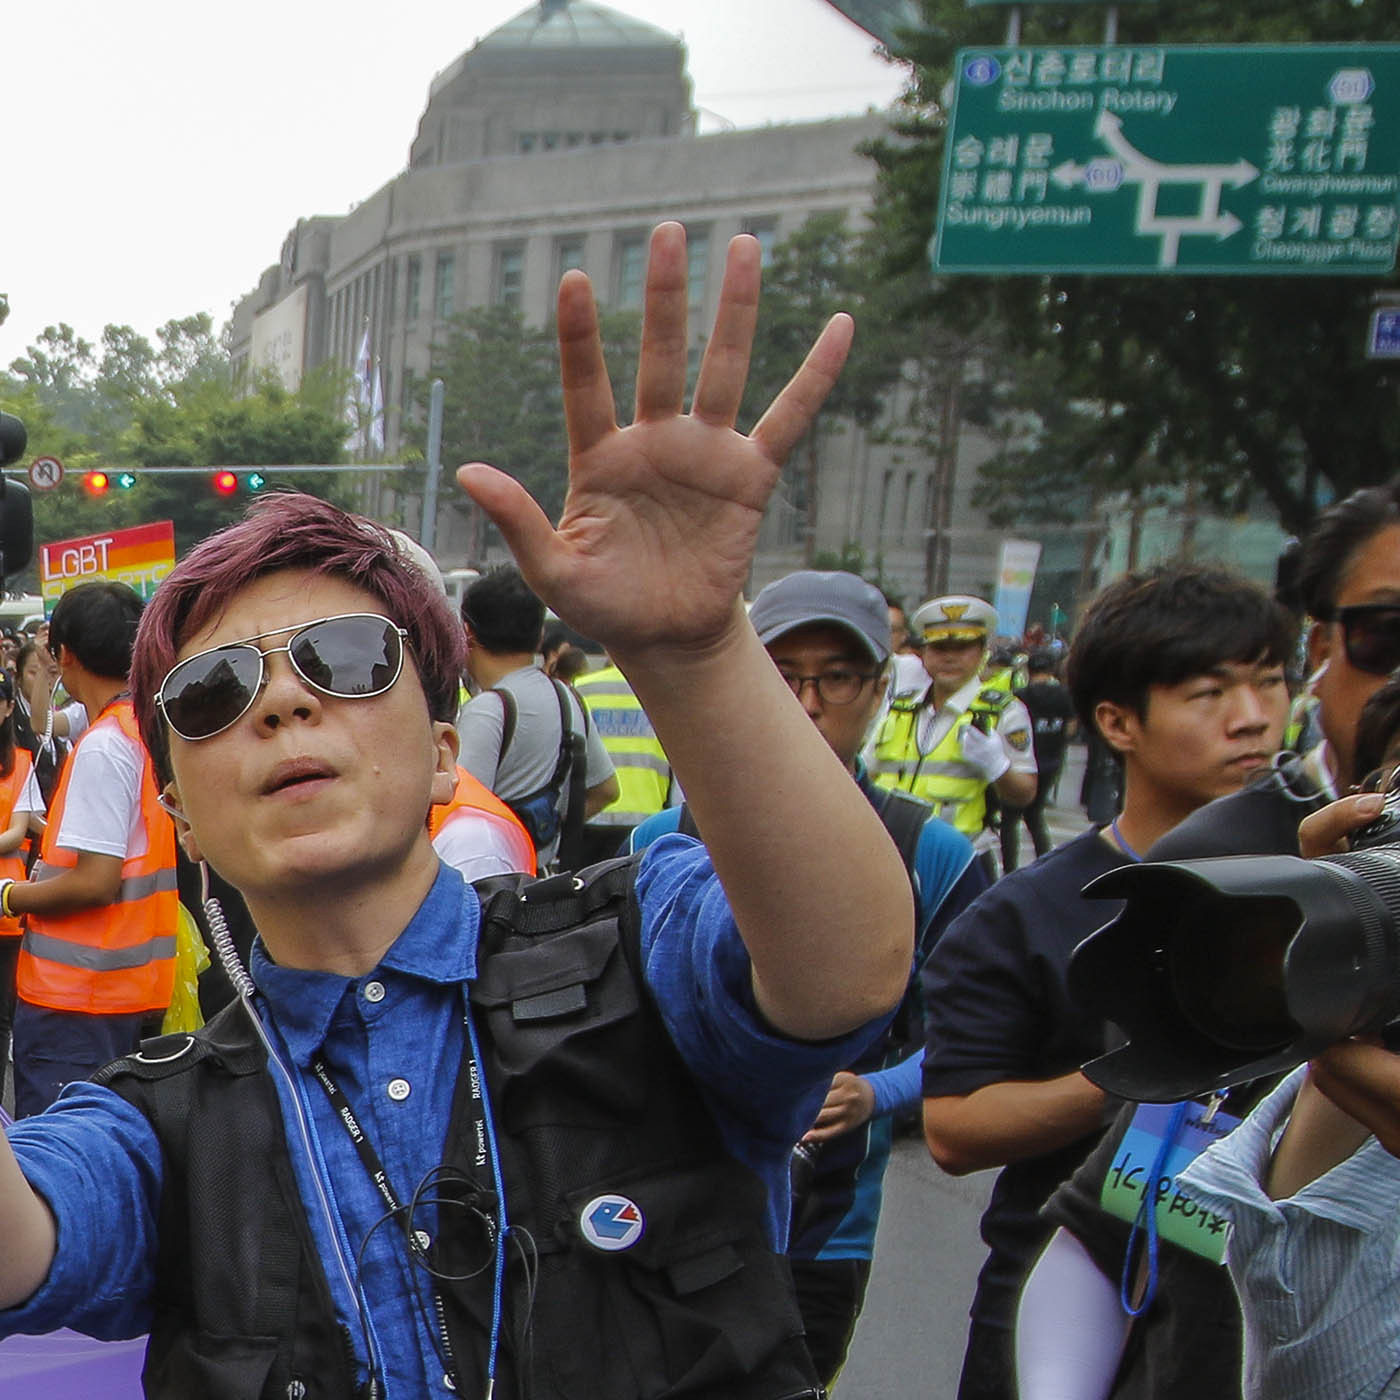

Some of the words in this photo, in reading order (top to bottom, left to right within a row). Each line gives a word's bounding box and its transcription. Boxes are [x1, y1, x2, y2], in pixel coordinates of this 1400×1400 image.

[1004, 50, 1166, 86] 신촌로터리
[1002, 90, 1094, 112] Sinchon
[1103, 88, 1177, 114] Rotary
[954, 132, 1054, 168] 숭례문
[946, 203, 1092, 229] Sungnyemun
[43, 538, 114, 581] LGBT
[476, 1153, 487, 1167] kt
[374, 1170, 385, 1184] kt
